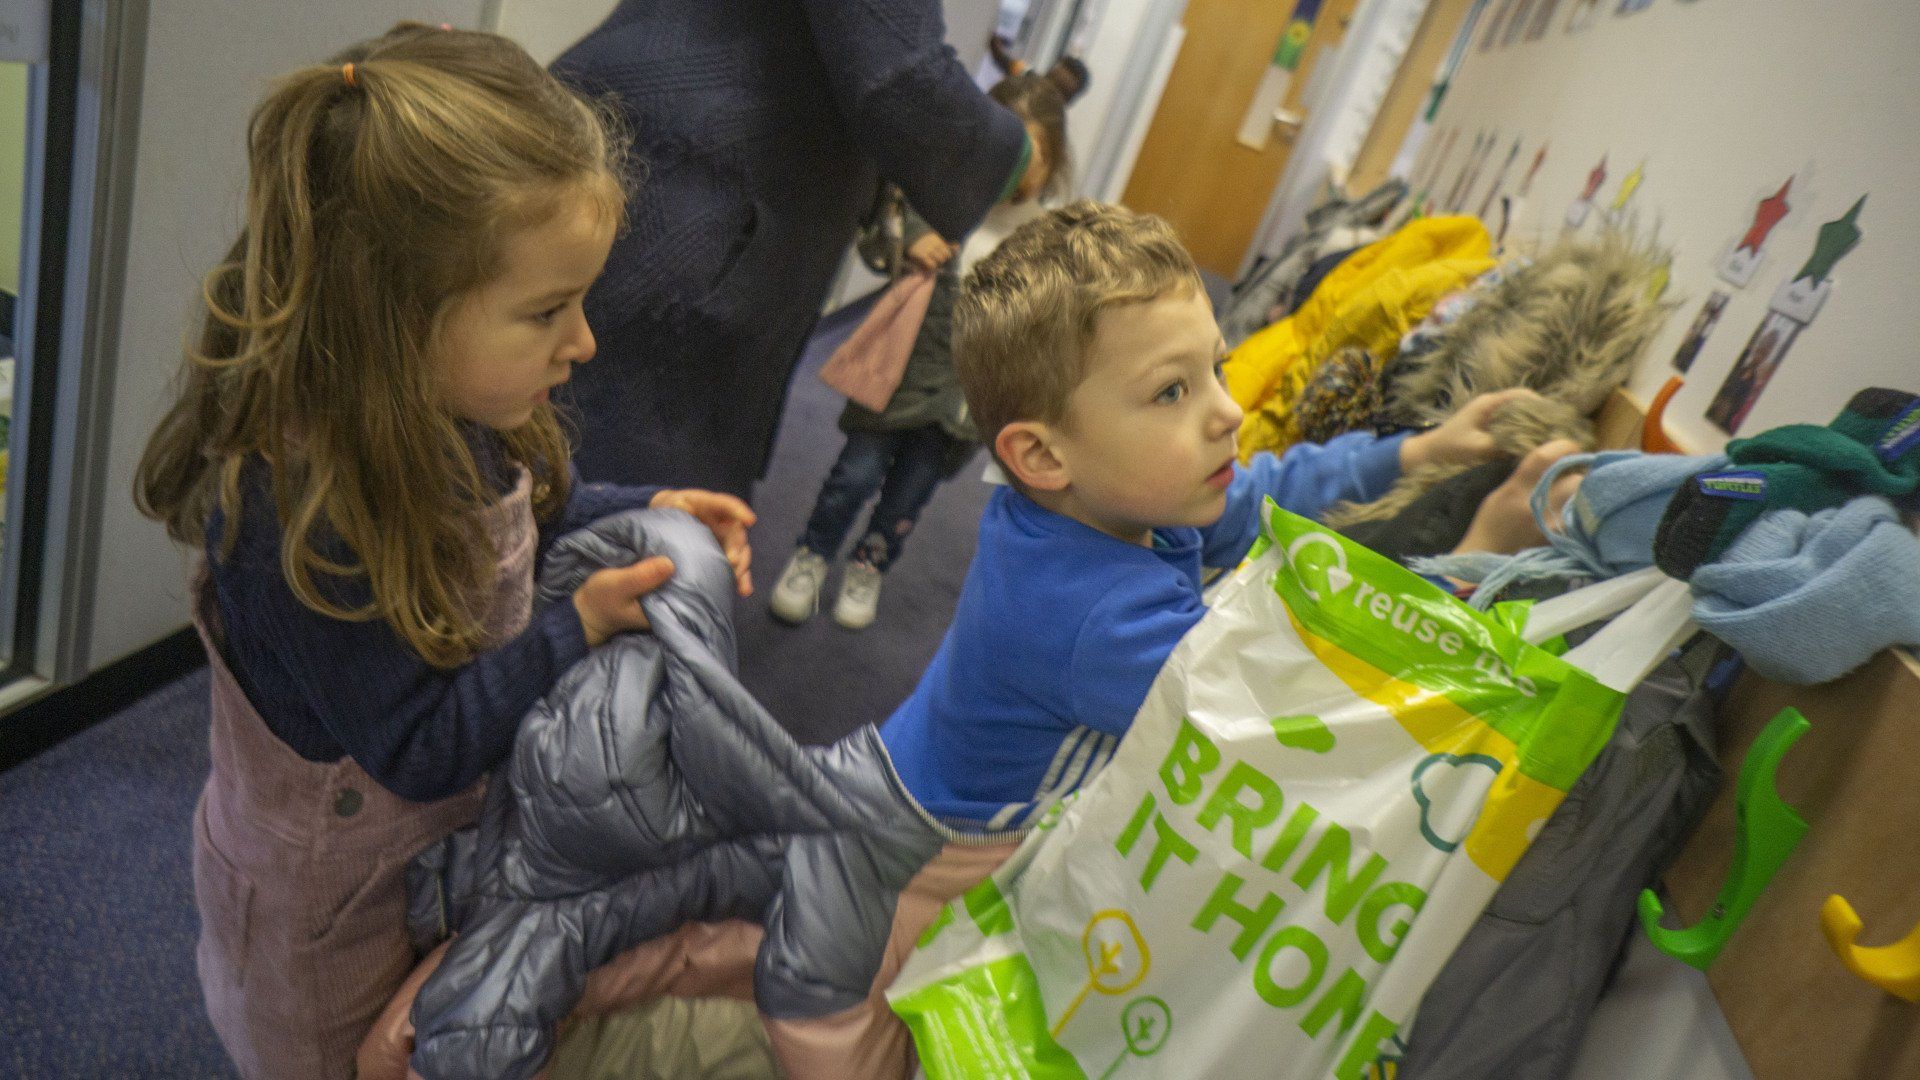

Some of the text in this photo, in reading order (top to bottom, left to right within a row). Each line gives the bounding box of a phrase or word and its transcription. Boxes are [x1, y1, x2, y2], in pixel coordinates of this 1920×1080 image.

[1354, 581, 1463, 656] reuse
[1114, 791, 1199, 893] IT
[1158, 717, 1428, 964] BRING
